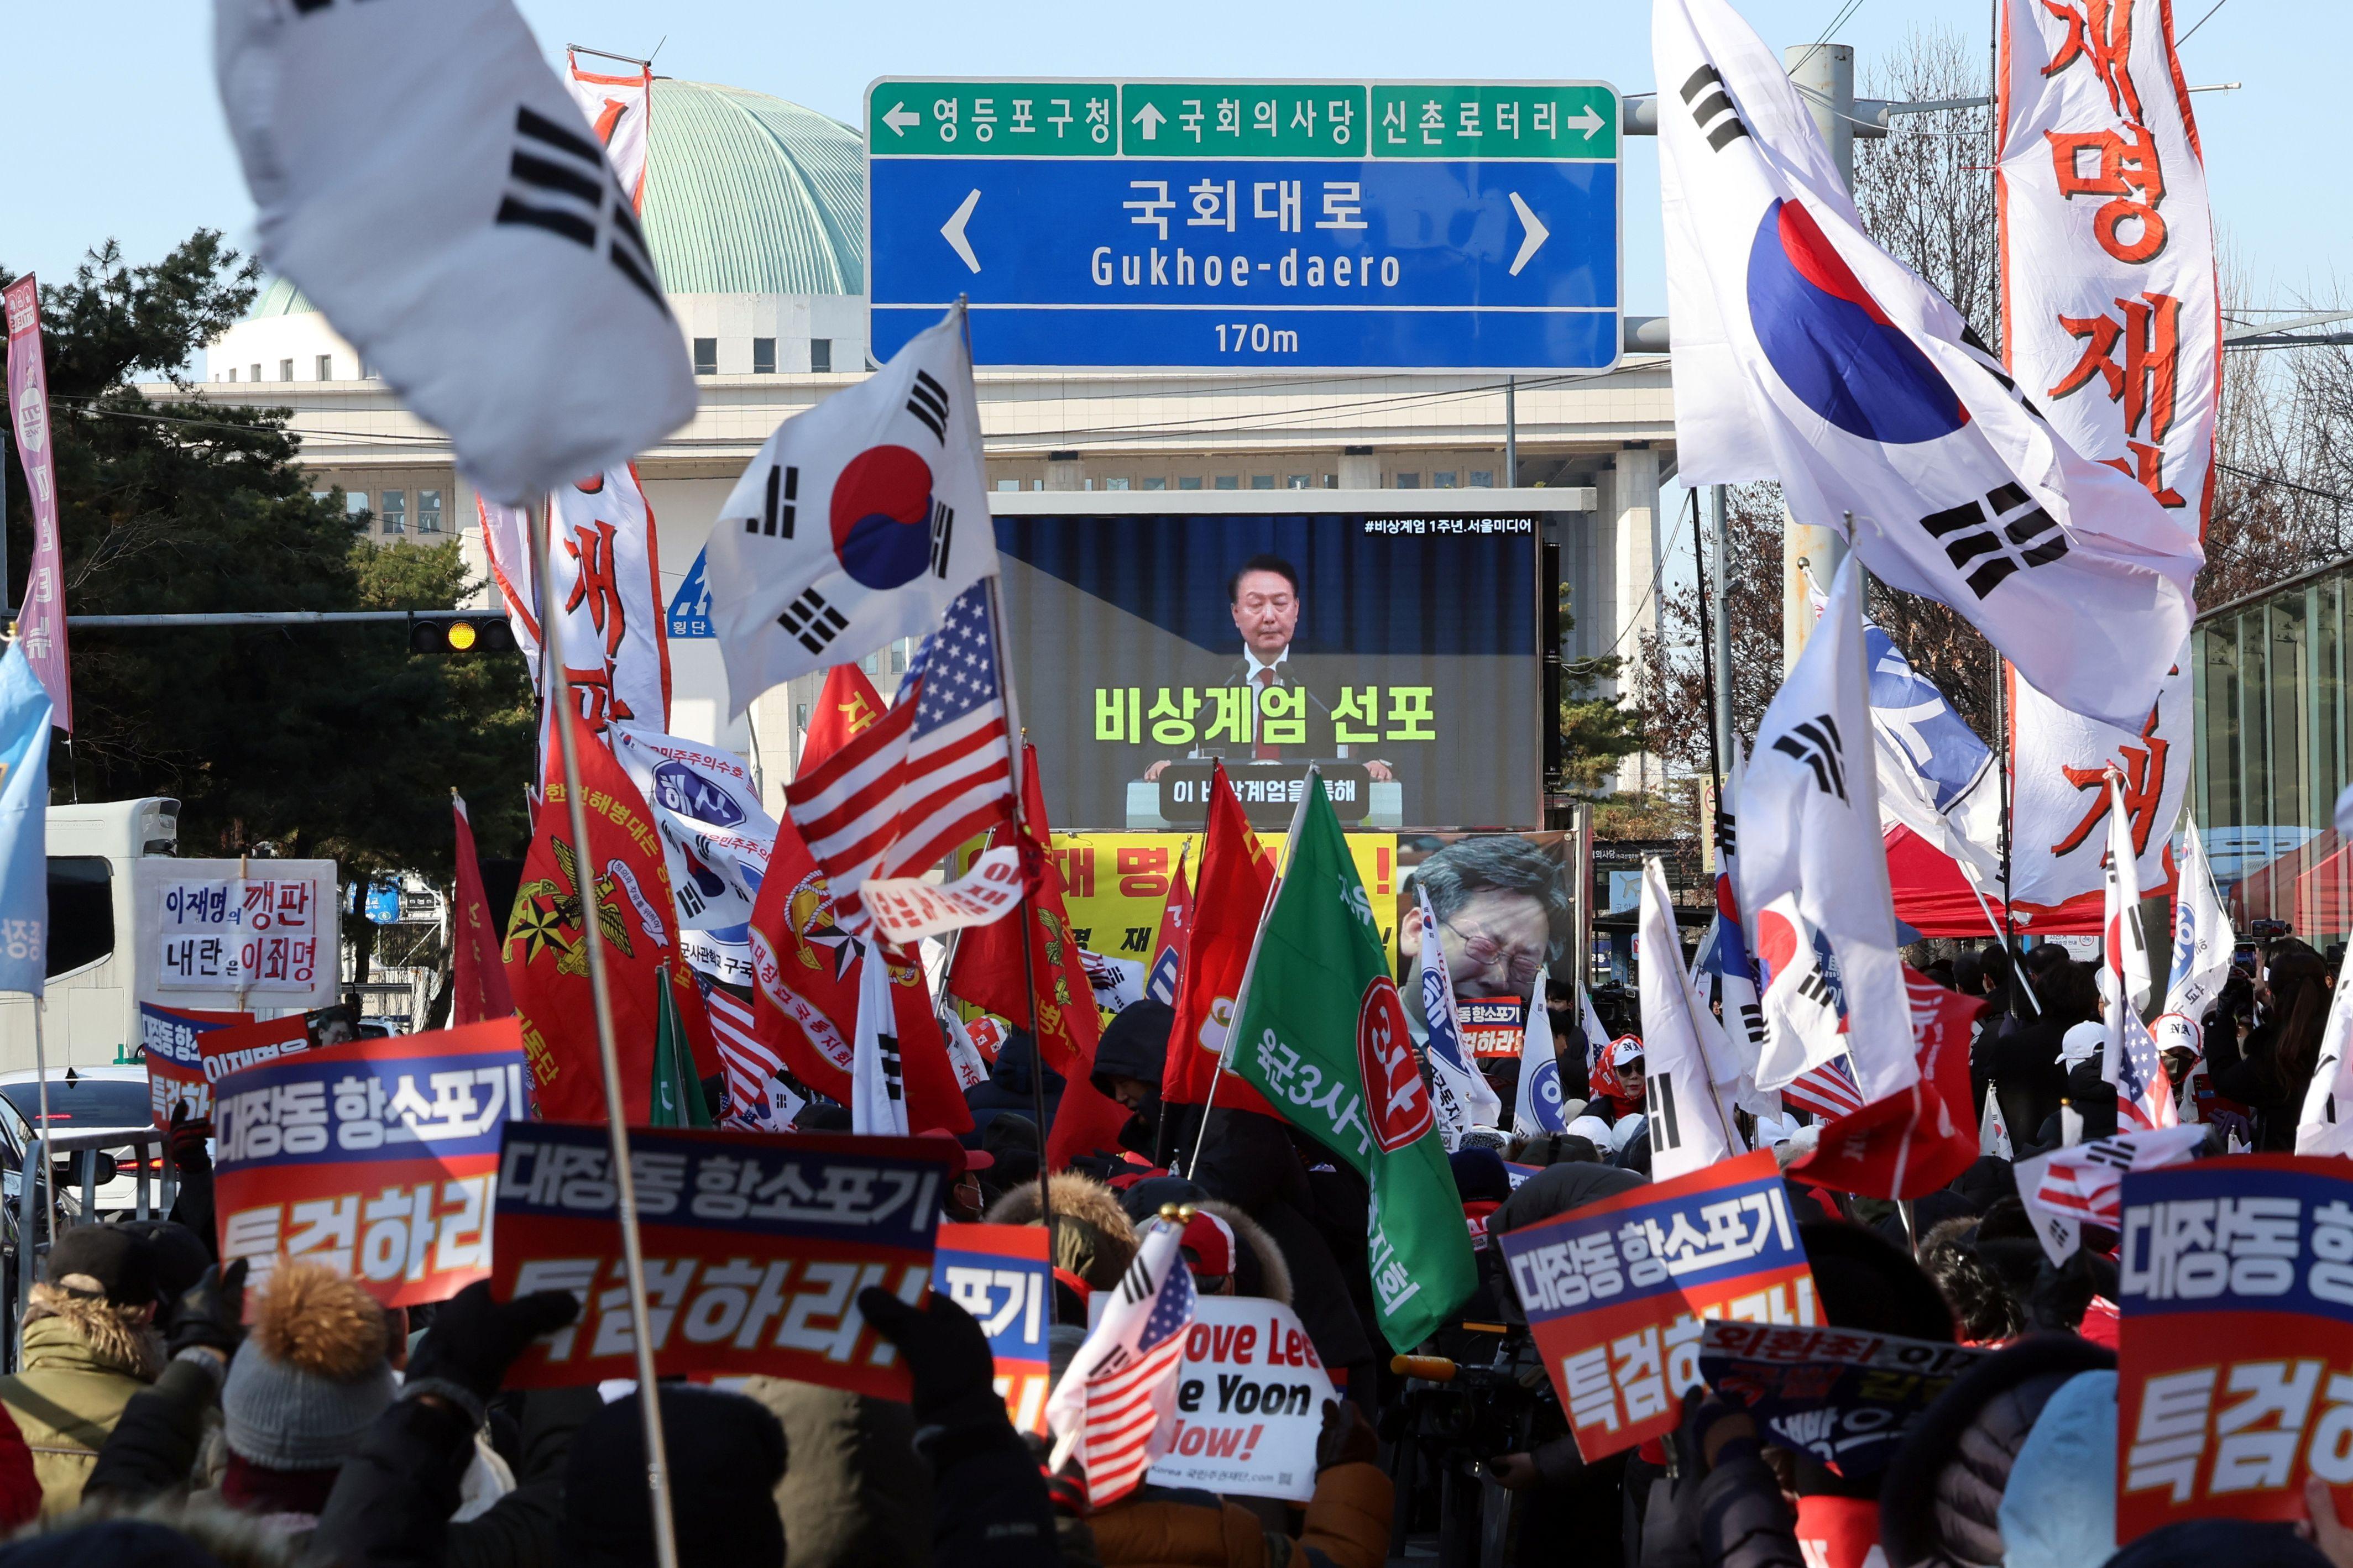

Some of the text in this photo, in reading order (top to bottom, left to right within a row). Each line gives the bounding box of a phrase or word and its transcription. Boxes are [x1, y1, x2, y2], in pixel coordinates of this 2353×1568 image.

[933, 97, 1110, 143] 영등포구청
[1179, 99, 1354, 145] 국회의사당
[1382, 101, 1557, 144] 신촌로터리
[1123, 179, 1368, 240] 국회대로
[1091, 247, 1400, 287] Gukhoe-daero
[1215, 323, 1298, 353] 170m
[1364, 518, 1531, 534] #비상계엄 1주년.서울미디어
[673, 622, 706, 634] 횡단
[1095, 686, 1436, 744] 비상계엄 선포
[1174, 780, 1193, 803] 이
[242, 881, 309, 931] 깽판
[168, 937, 317, 982] 내란은 이죄명
[142, 1013, 174, 1058] 대장동
[1473, 1006, 1520, 1023] 항소포기
[217, 1063, 524, 1160] 대장동 항소포기
[498, 1141, 941, 1233] 대장동 항소포기
[1510, 1187, 1795, 1312] 대장동 항소포기
[2121, 1197, 2301, 1300] 대장동
[1185, 1318, 1320, 1369] ove Lee
[1178, 1373, 1311, 1416] e Yoon
